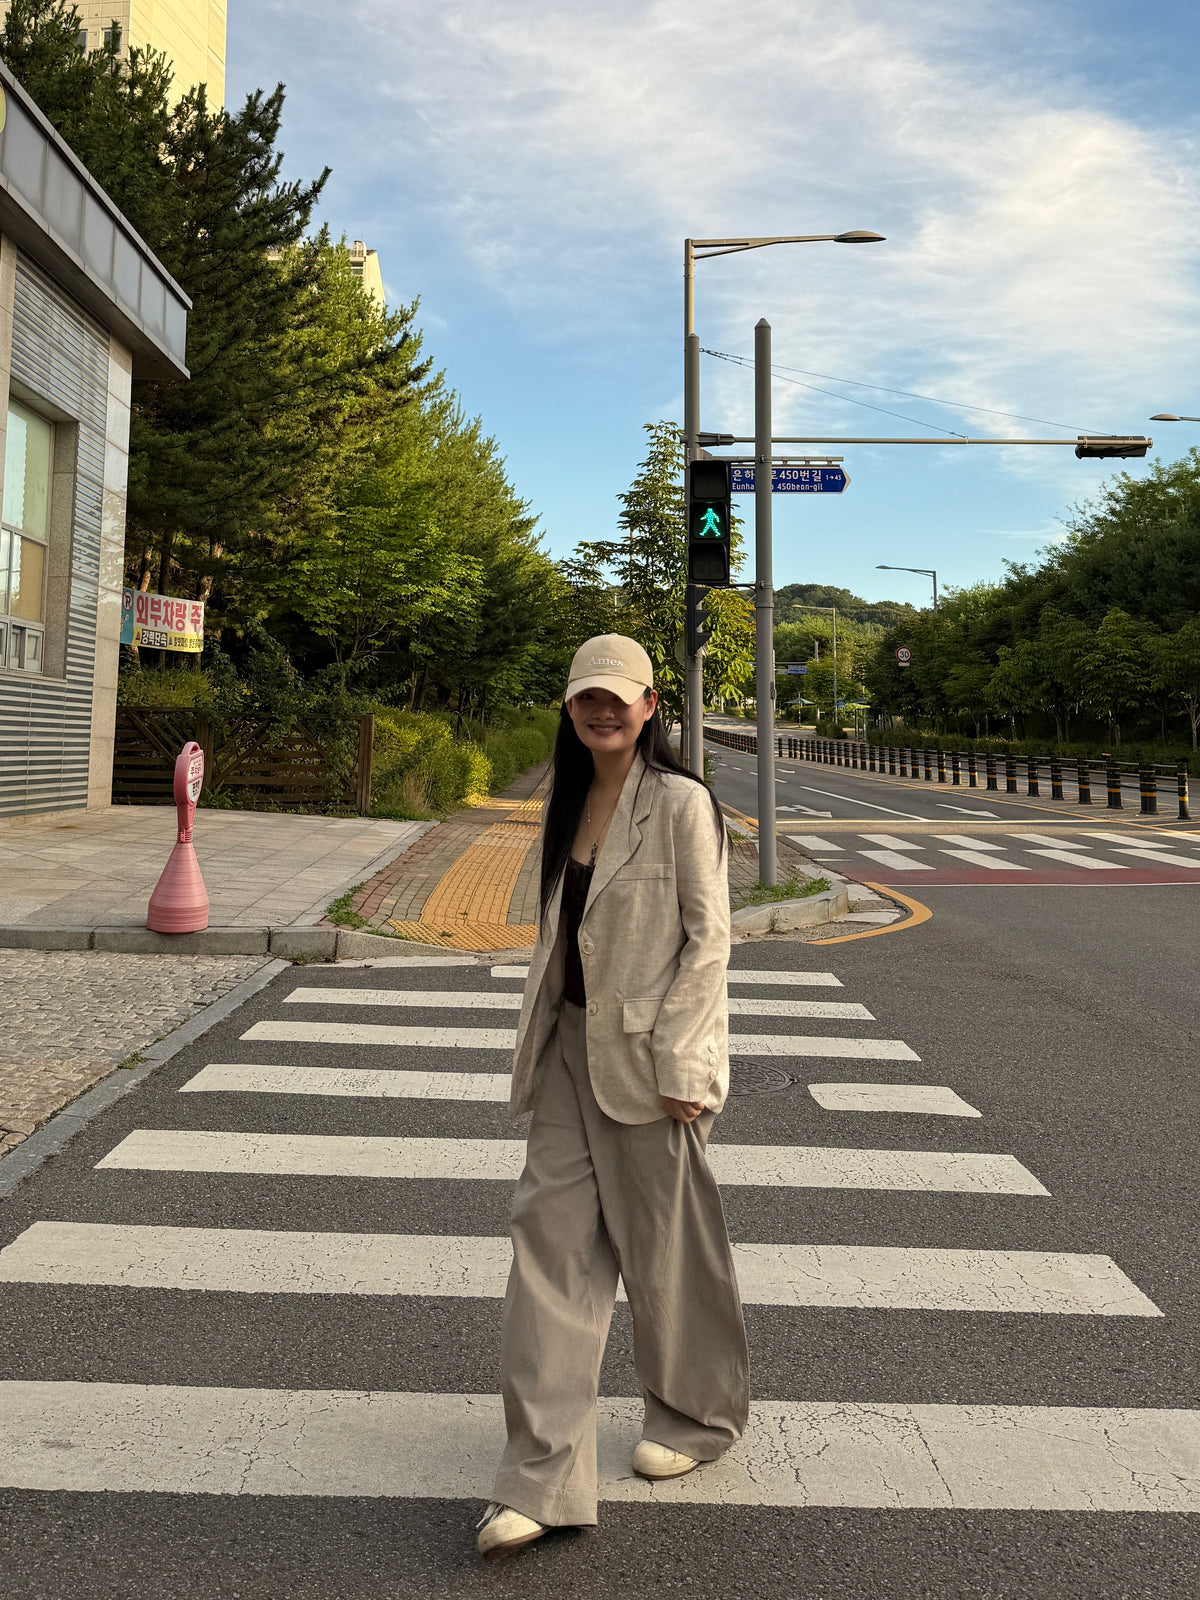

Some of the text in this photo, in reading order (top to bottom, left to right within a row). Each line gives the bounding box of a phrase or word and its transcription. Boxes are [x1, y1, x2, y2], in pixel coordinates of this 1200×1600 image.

[732, 469, 822, 482] 은하로450번길
[136, 594, 204, 633] 외부차량 주
[142, 630, 167, 647] 강력단속
[899, 650, 910, 659] 30
[587, 655, 624, 668] Ames
